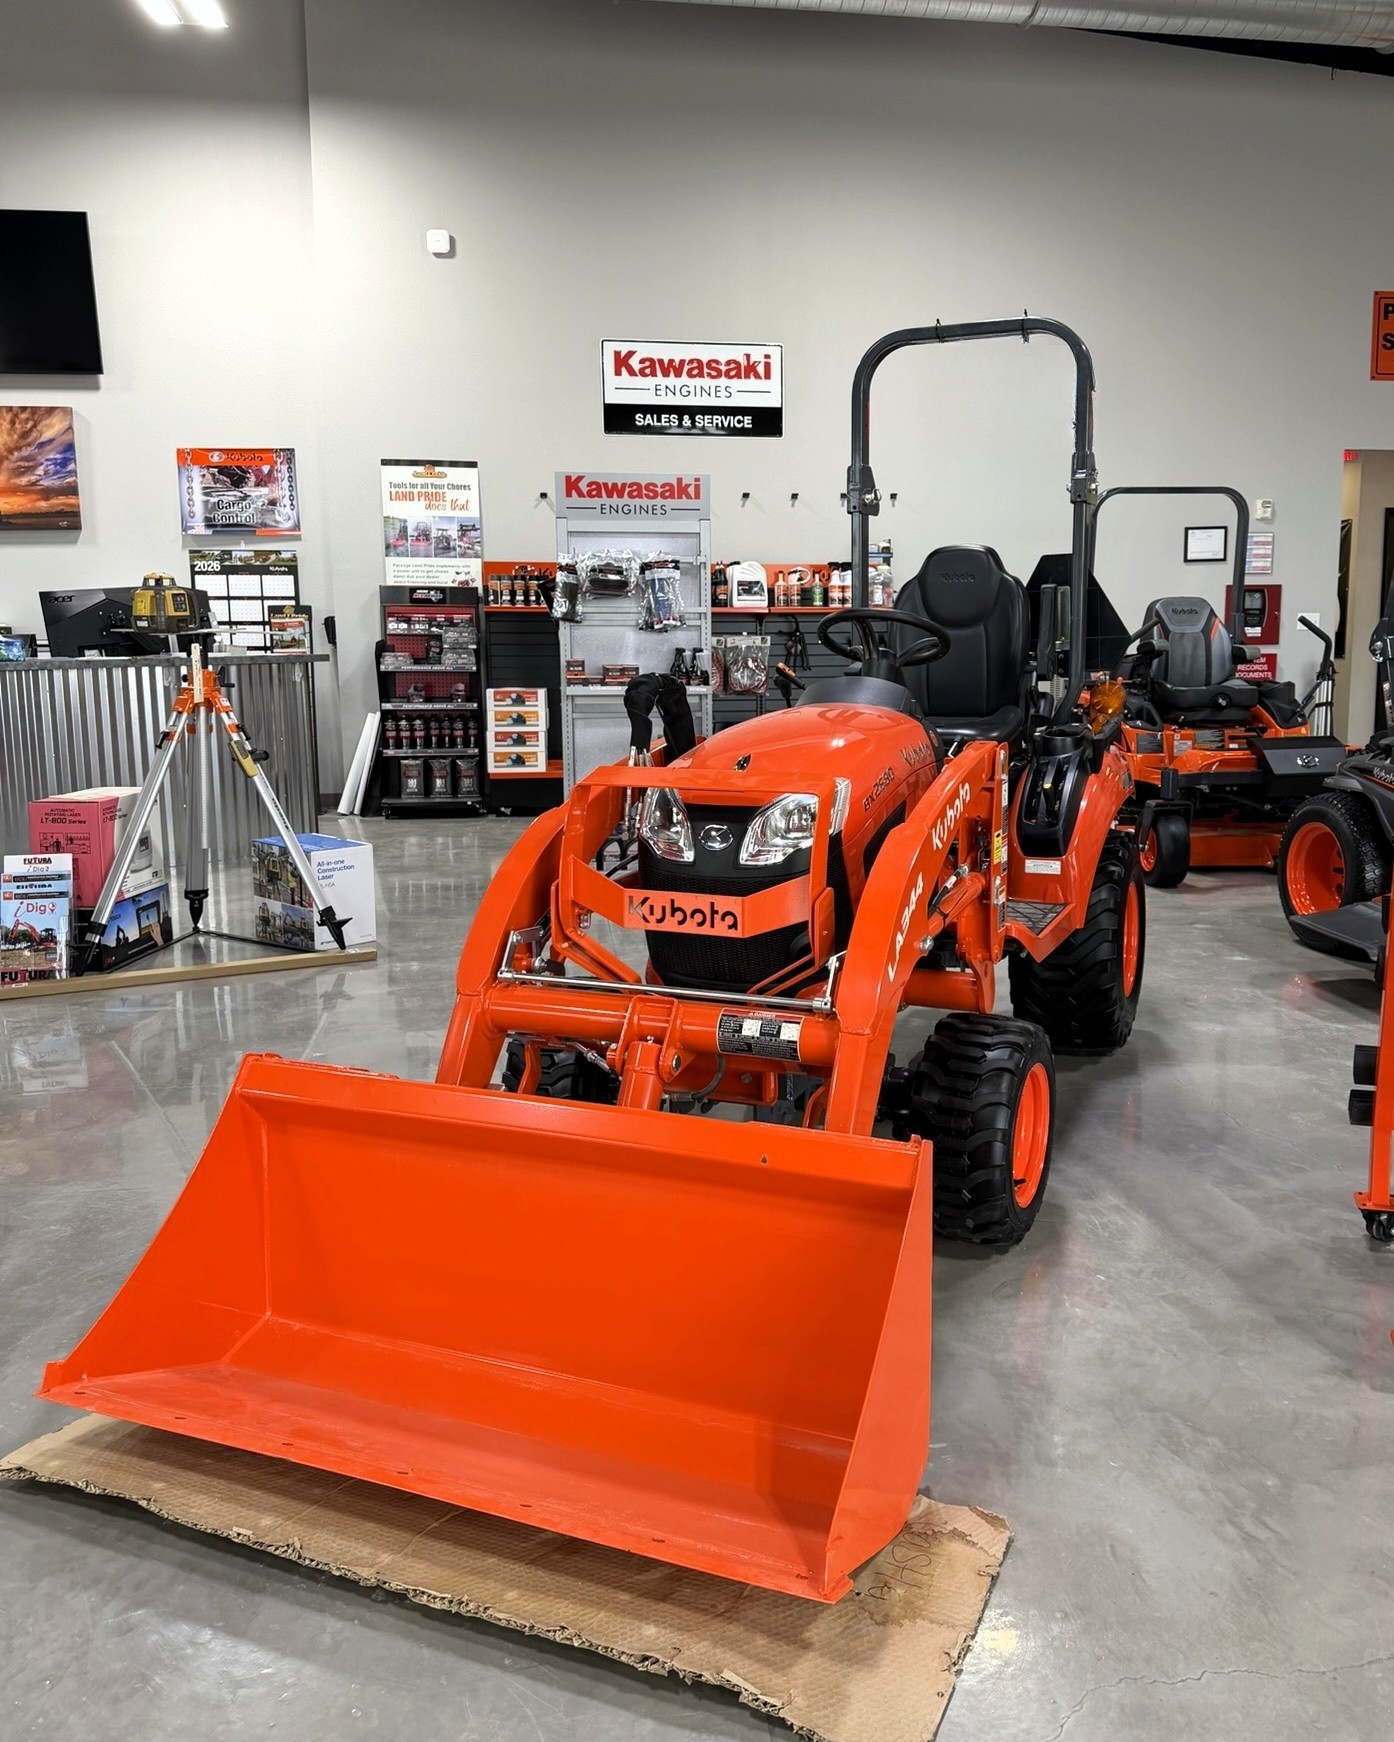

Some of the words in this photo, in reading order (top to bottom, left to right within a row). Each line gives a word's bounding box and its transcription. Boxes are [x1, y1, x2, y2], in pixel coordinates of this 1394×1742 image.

[613, 349, 772, 380] Kawasaki
[654, 384, 733, 398] ENGINES
[635, 413, 679, 426] SALES
[682, 414, 692, 426] &
[695, 415, 753, 428] SERVICE
[226, 452, 264, 462] Kubota
[389, 481, 408, 489] Tools
[420, 482, 429, 490] all
[430, 482, 446, 490] Your
[446, 483, 471, 491] Chores
[564, 474, 701, 500] Kawasaki
[389, 490, 415, 501] LAND
[417, 491, 447, 502] PRIDE
[216, 500, 252, 512] Cargo
[425, 499, 447, 511] does
[600, 503, 667, 515] ENGINES
[212, 513, 255, 523] Control
[194, 560, 221, 571] 2026
[49, 594, 76, 604] acer
[1170, 607, 1199, 615] Kubota
[931, 782, 971, 851] Kubota
[23, 857, 52, 865] FUTURA
[317, 858, 345, 868] All-in-one
[317, 864, 355, 875] Construction
[317, 873, 335, 881] Laser
[628, 896, 739, 931] Kubota
[887, 872, 924, 983] LA344
